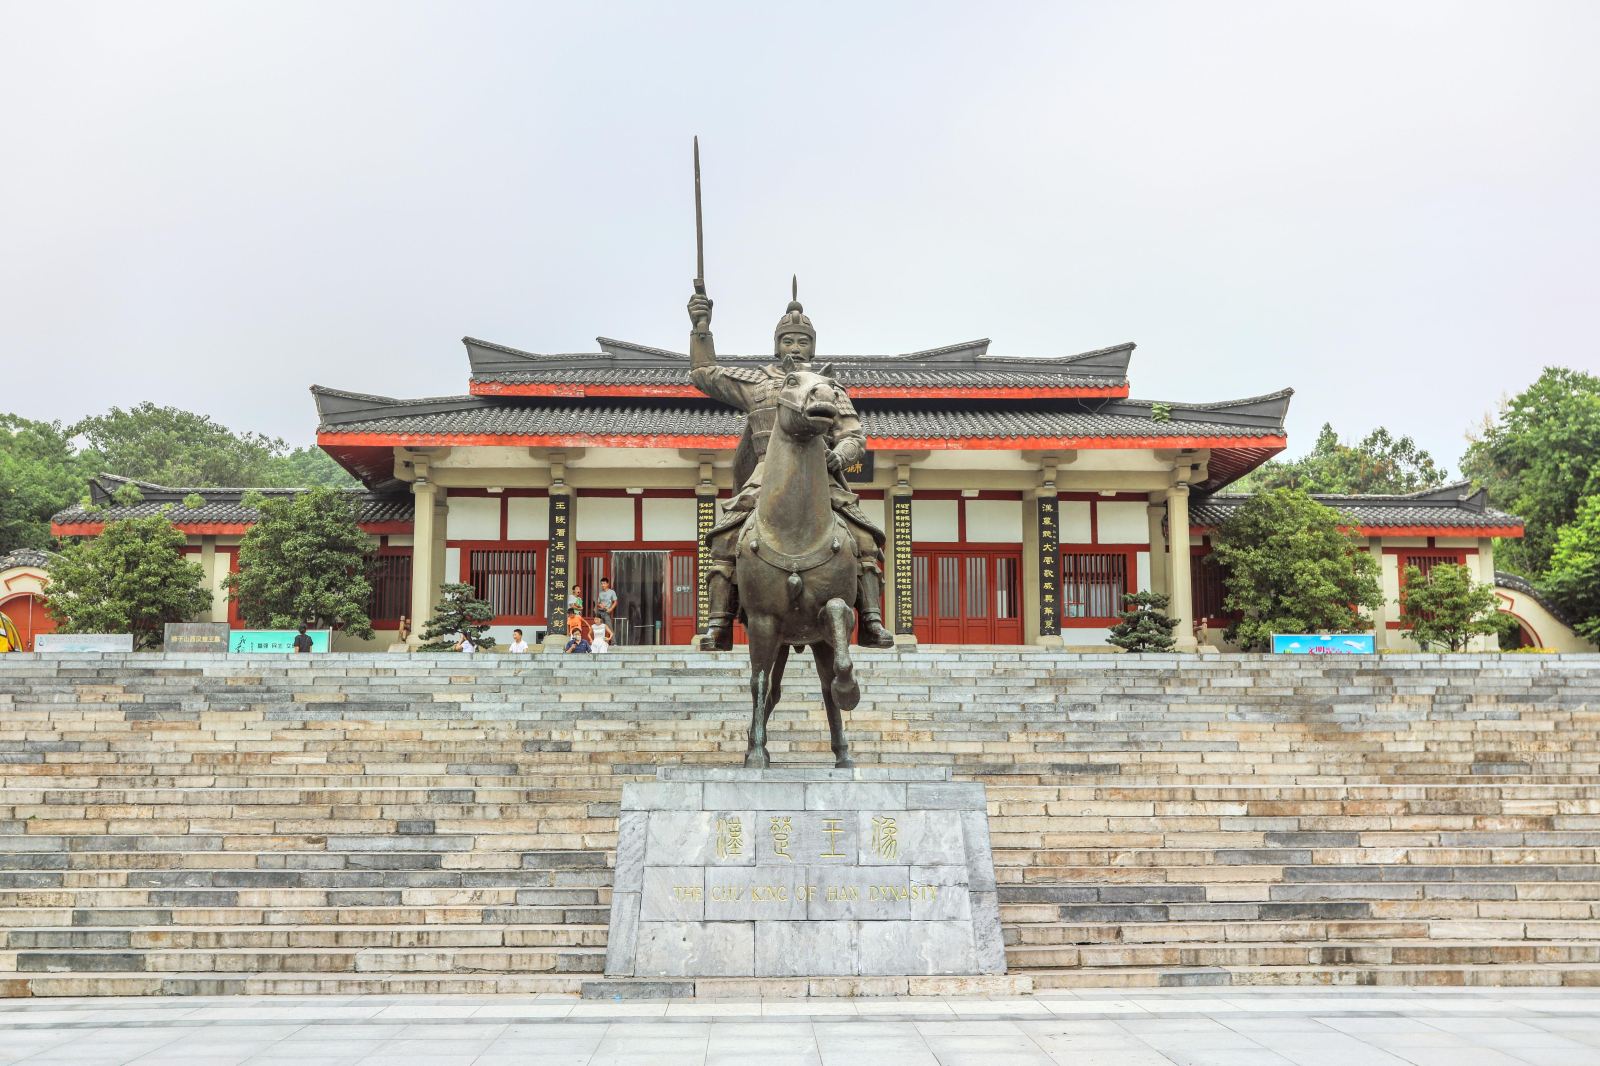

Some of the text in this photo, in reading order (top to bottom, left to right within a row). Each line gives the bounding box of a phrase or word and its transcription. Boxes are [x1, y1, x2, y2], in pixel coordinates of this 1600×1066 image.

[716, 815, 898, 863] 漢楚王像
[673, 886, 938, 902] THE CHU KING OF HAN DYNASTY
